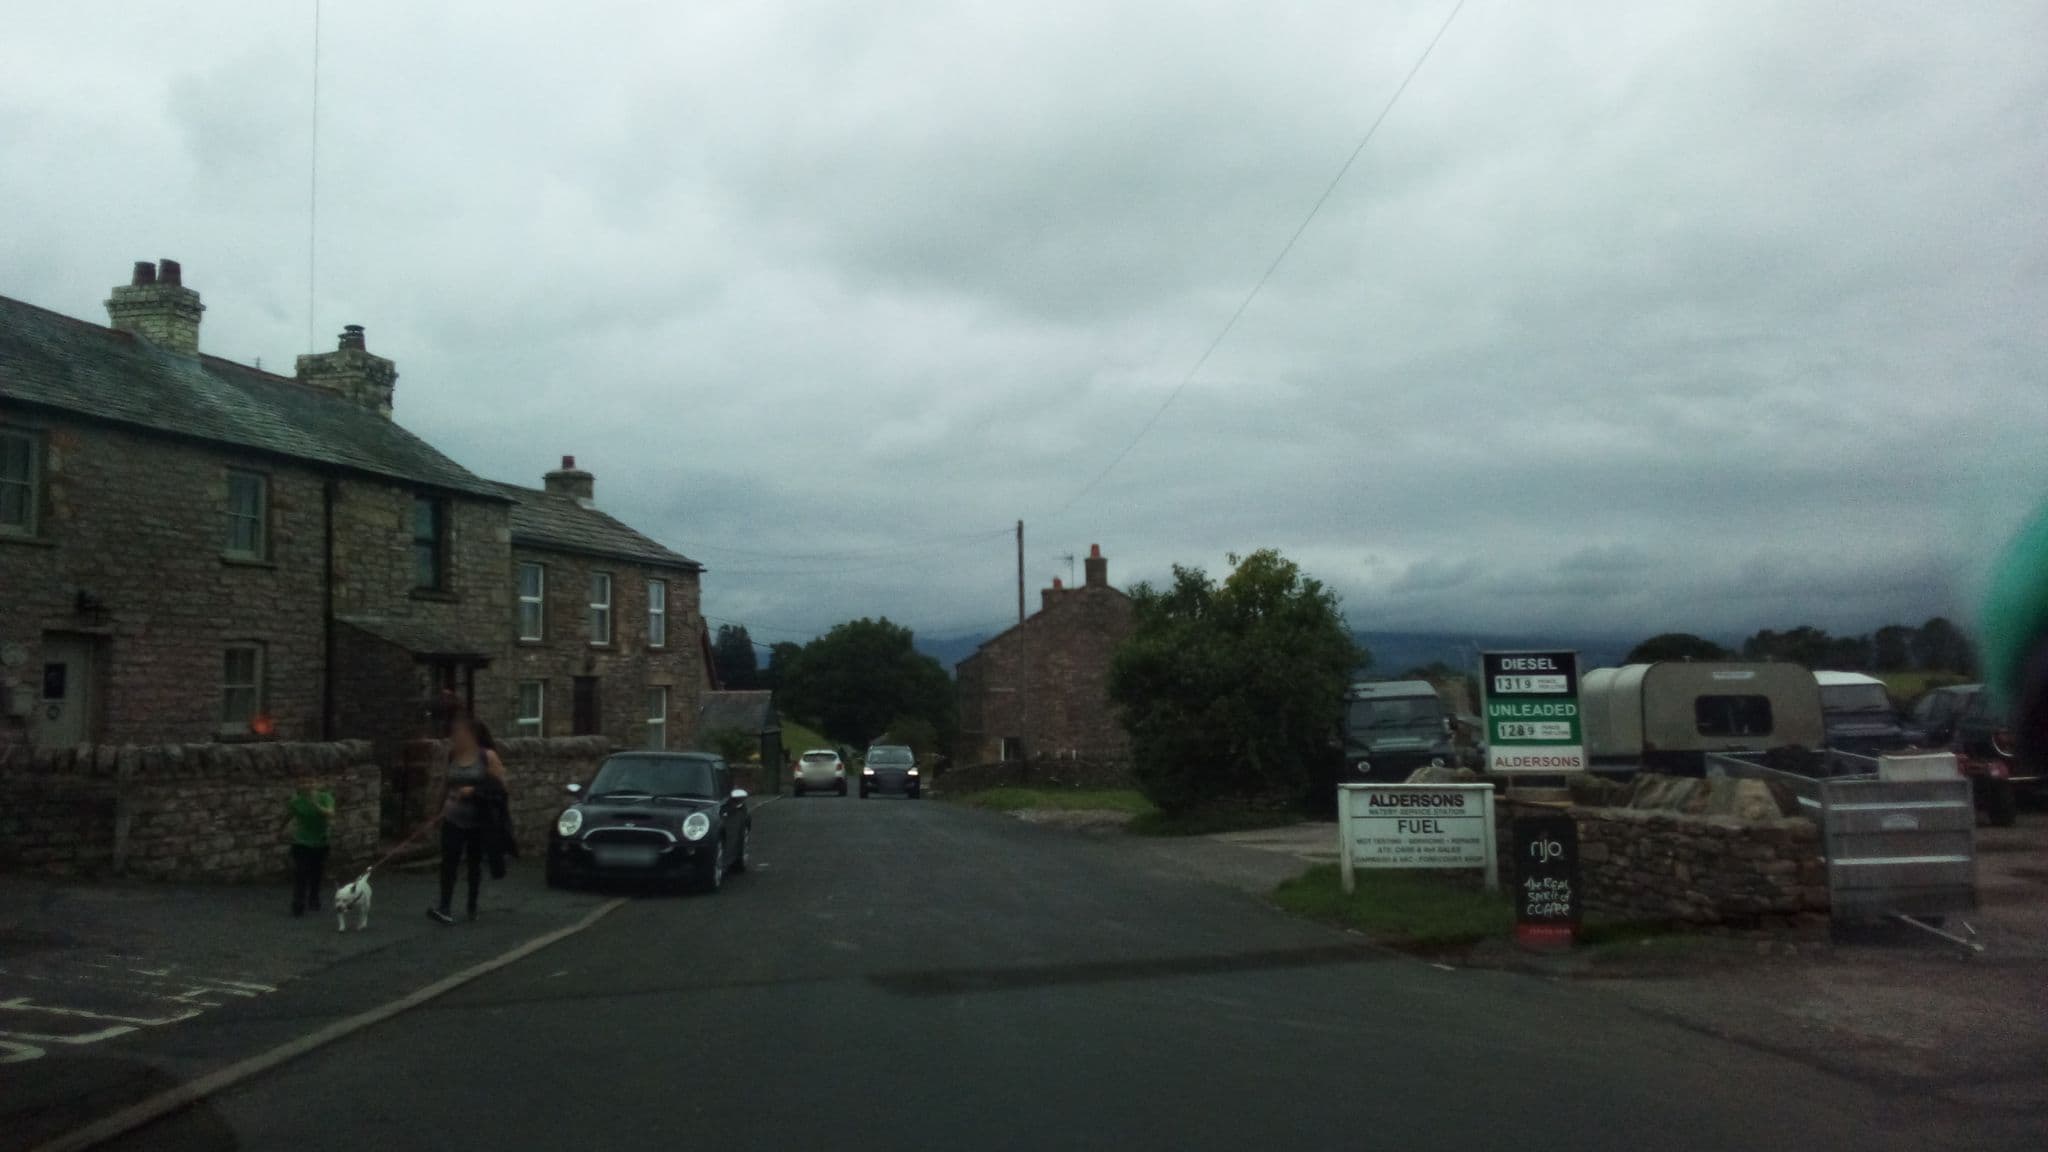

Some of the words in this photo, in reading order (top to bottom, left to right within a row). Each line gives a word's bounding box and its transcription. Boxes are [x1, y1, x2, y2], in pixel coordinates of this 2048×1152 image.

[1502, 658, 1558, 670] DIESEL
[1489, 704, 1577, 716] UNLEADED
[1496, 756, 1580, 767] ALDERSONS
[1369, 794, 1465, 807] ALDERSONS
[1398, 820, 1444, 833] FUEL
